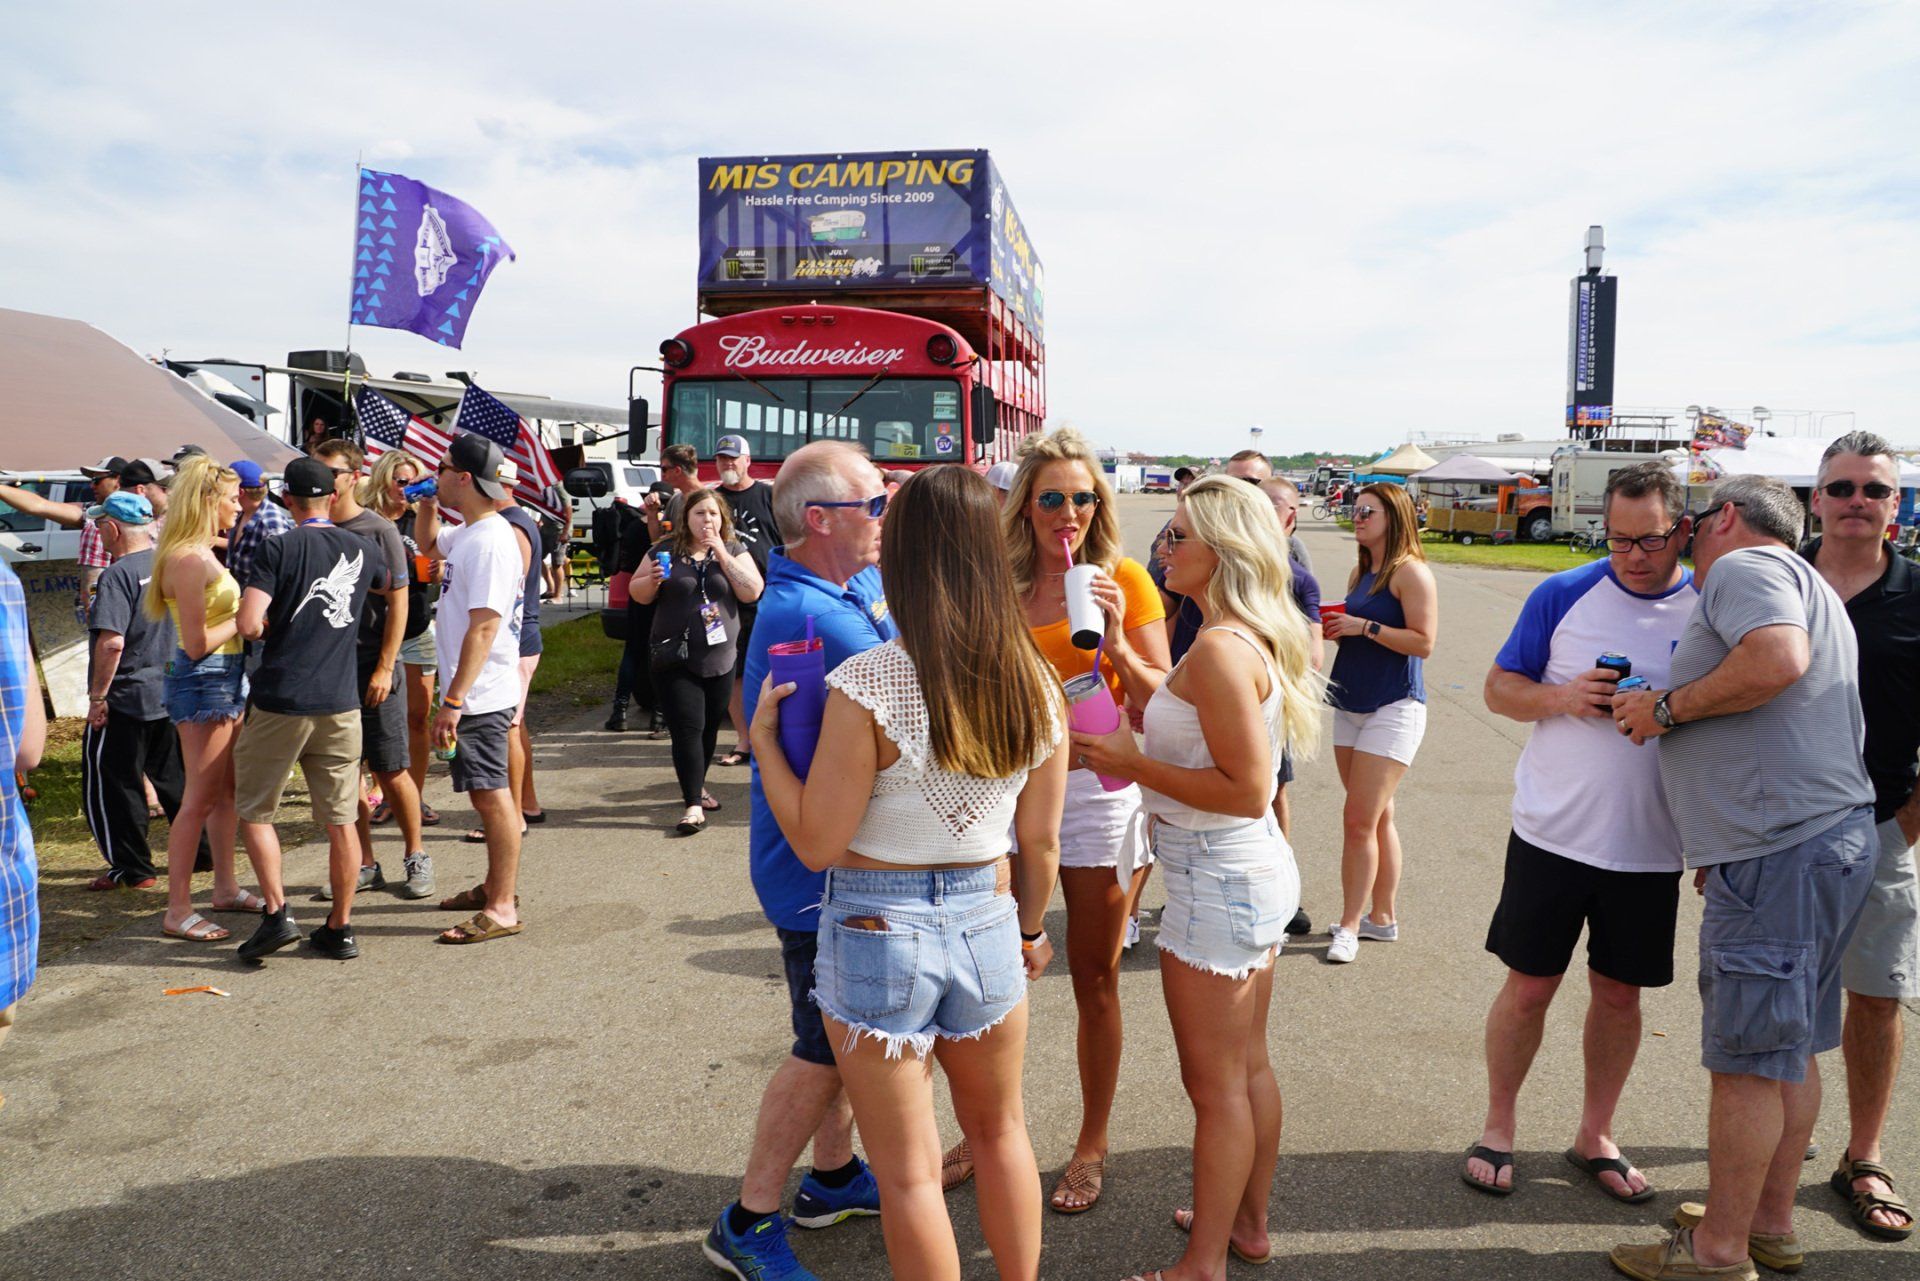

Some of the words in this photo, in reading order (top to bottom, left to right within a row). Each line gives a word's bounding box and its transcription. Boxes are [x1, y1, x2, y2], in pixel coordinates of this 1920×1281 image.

[708, 164, 782, 190] MIS
[789, 159, 975, 188] CAMPING
[745, 195, 783, 206] Hassle
[786, 195, 811, 206] Free
[814, 193, 867, 207] Camping
[870, 192, 902, 204] Since
[904, 192, 934, 203] 2009
[798, 258, 857, 268] FASTER
[792, 267, 852, 277] HORSES
[719, 335, 904, 368] Budweiser
